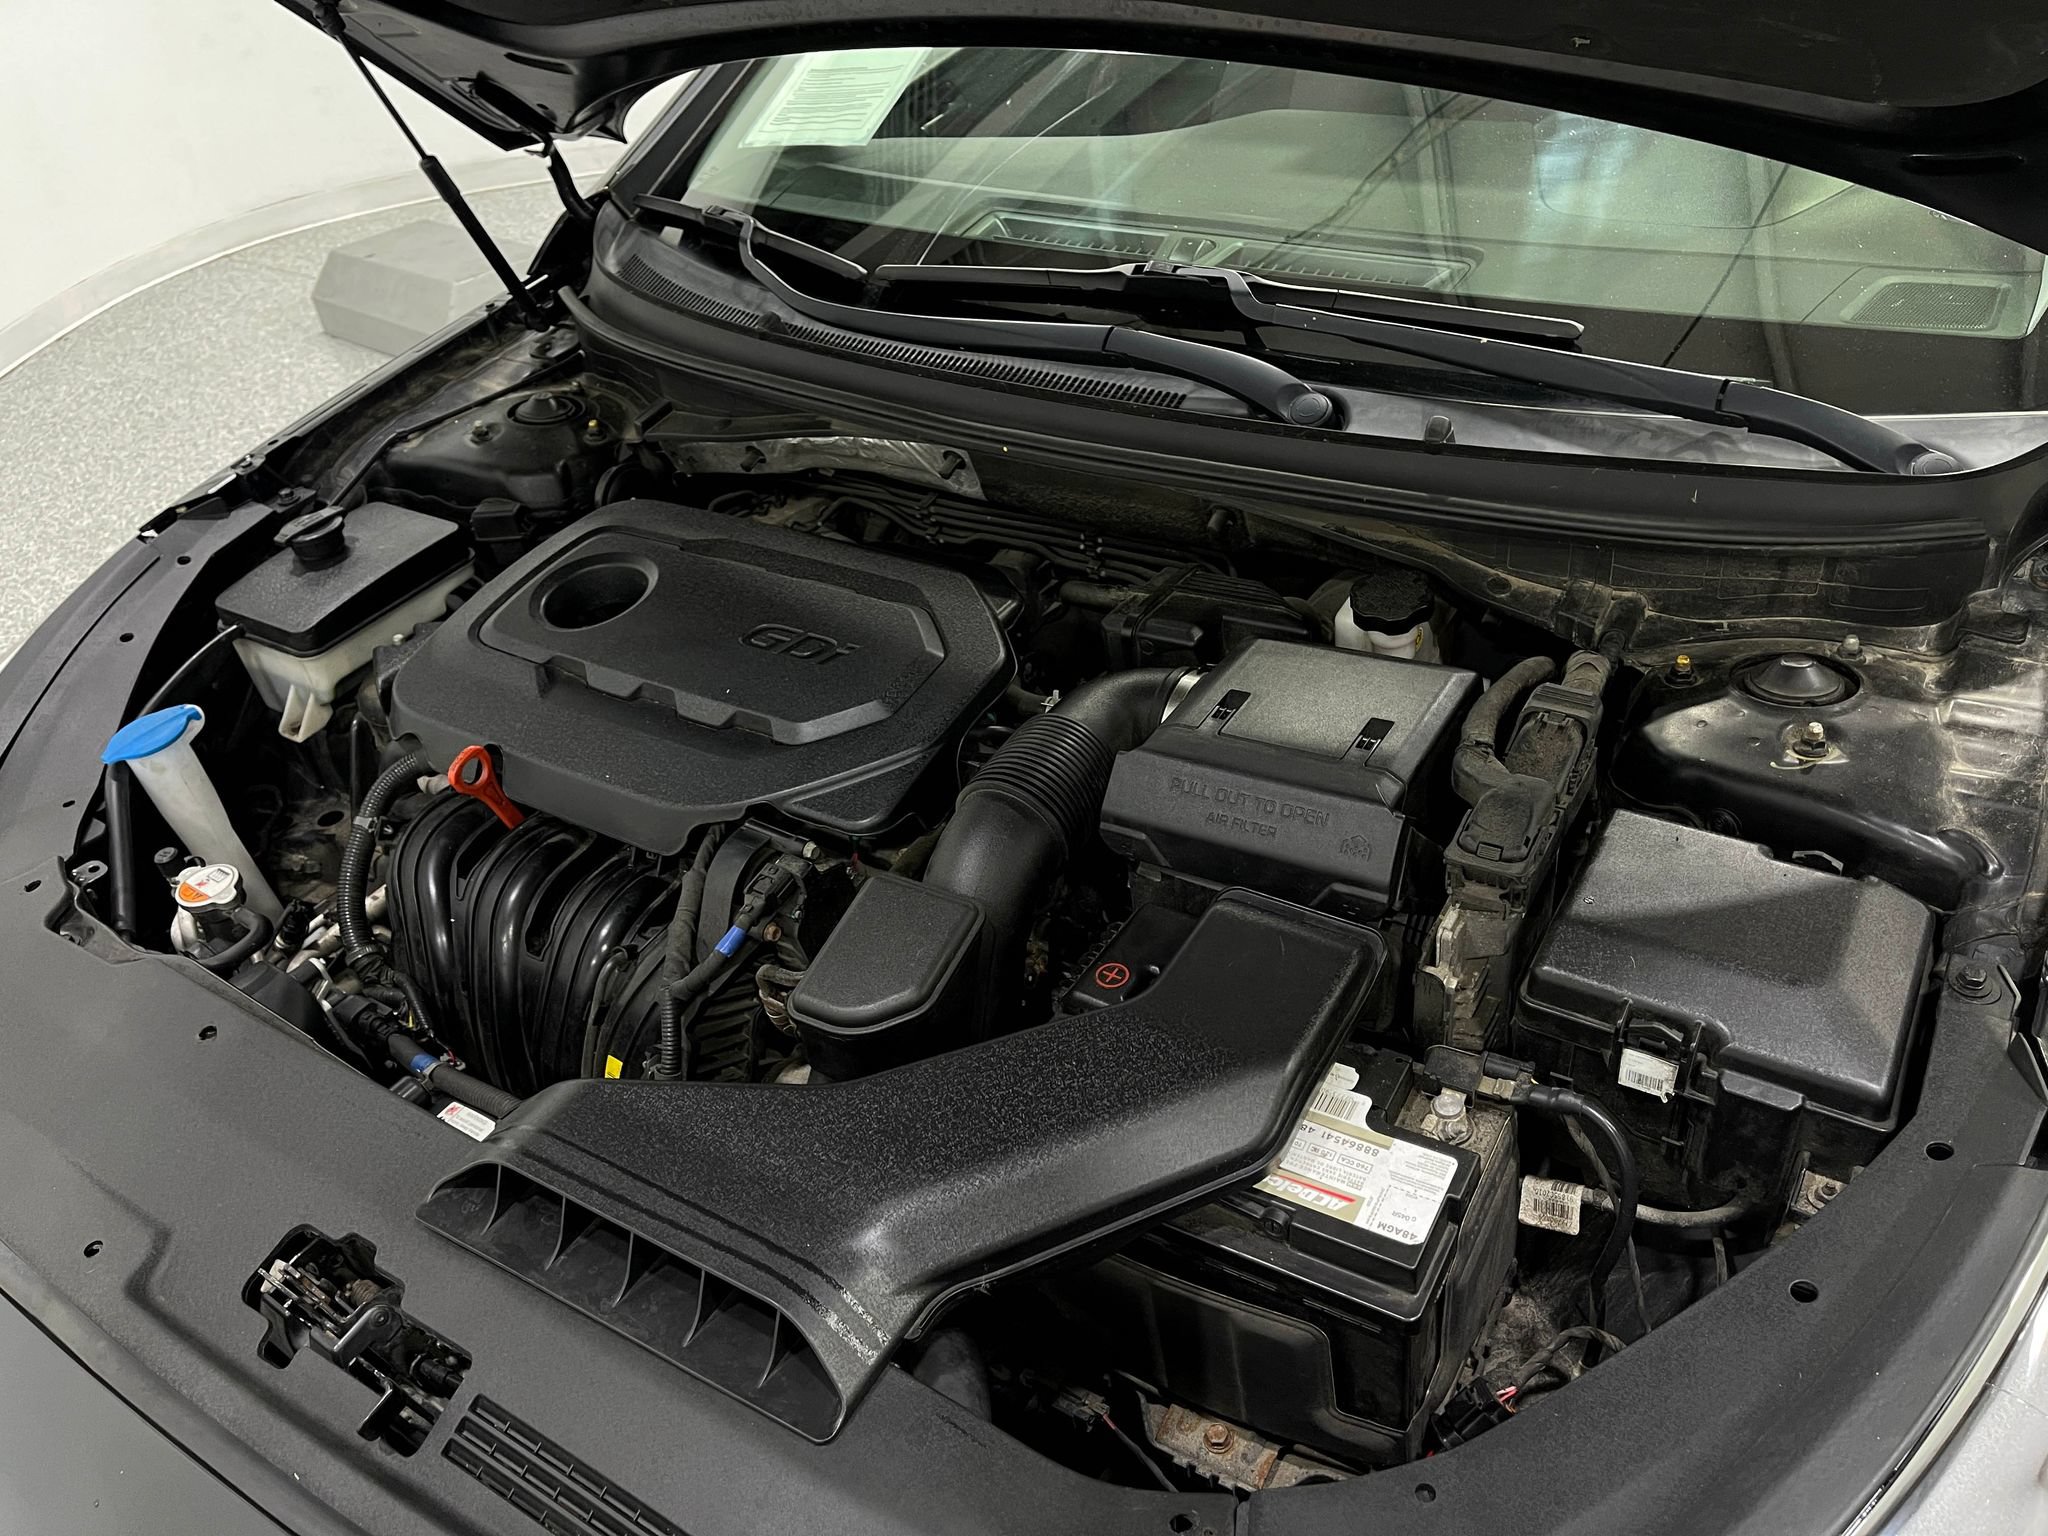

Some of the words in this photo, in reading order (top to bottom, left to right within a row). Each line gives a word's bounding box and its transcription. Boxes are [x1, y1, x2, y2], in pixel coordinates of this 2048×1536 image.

[1170, 777, 1209, 799] PULL
[1215, 788, 1251, 805] OUT
[1254, 796, 1277, 814] TO
[1280, 803, 1330, 827] OPEN
[1205, 811, 1229, 827] AIR
[1231, 818, 1278, 839] FILTER
[1376, 1220, 1419, 1241] 48AGM
